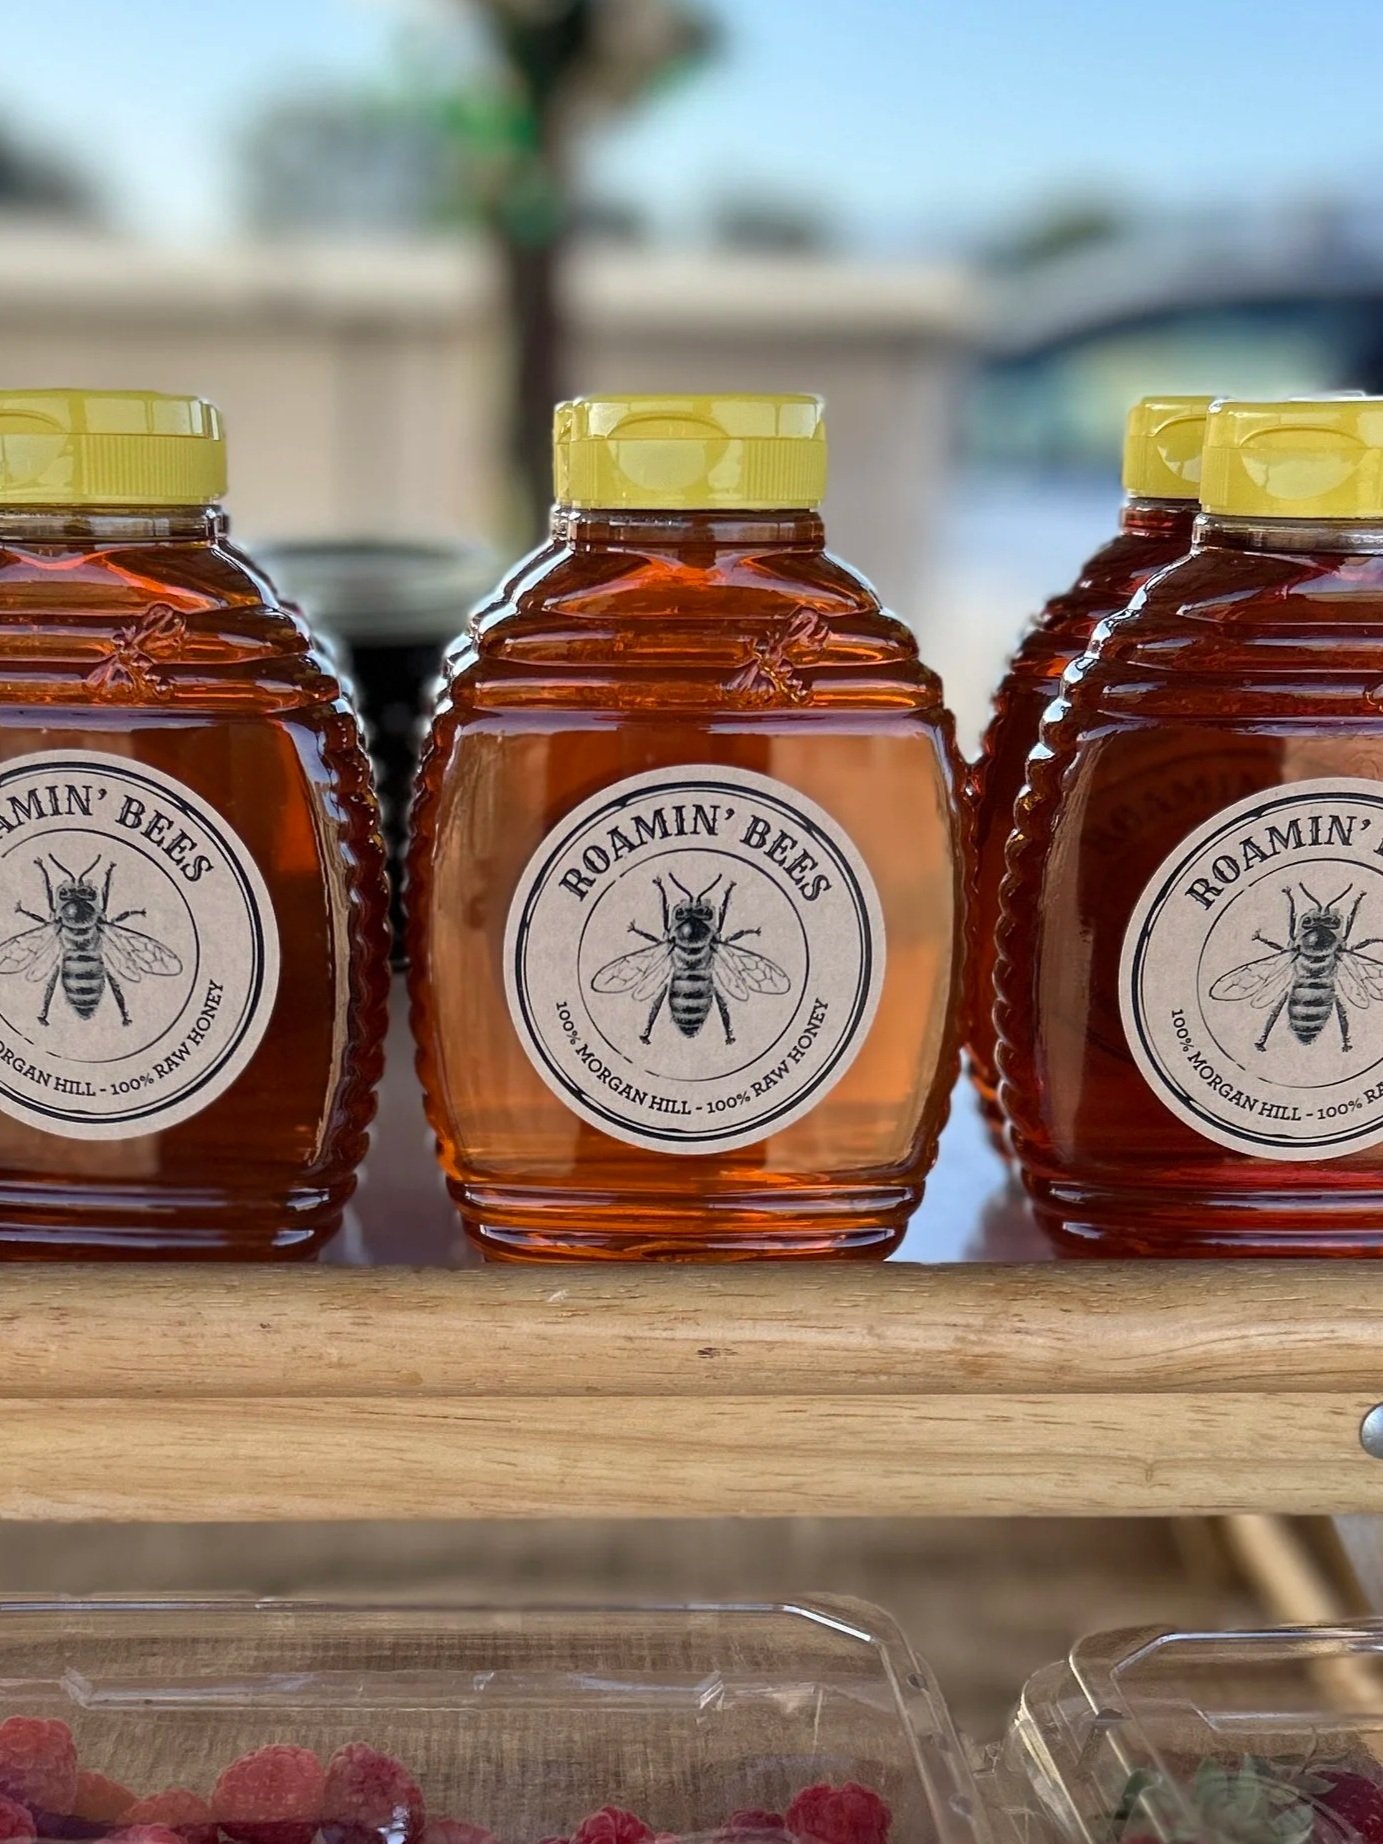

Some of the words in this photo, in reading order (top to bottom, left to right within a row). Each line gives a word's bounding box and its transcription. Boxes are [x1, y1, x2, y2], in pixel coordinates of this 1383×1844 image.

[0, 785, 107, 838] AMIN'
[115, 795, 214, 882] BEES
[559, 804, 735, 903] ROAMIN'
[740, 815, 832, 903] BEES
[1185, 815, 1371, 910] ROAMIN'
[54, 1078, 95, 1096] HILL
[111, 1073, 154, 1095] 100%
[153, 1042, 190, 1079] RAW
[186, 980, 223, 1044] HONEY
[556, 1001, 581, 1045] 100%
[576, 1043, 649, 1106] MORGAN
[648, 1096, 691, 1115] HILL
[707, 1093, 751, 1114] 100%
[750, 1061, 790, 1097] RAW
[788, 998, 829, 1064] HONEY
[1171, 1009, 1193, 1052] 100%
[1188, 1051, 1259, 1112] MORGAN
[1259, 1103, 1301, 1121] HILL
[1317, 1099, 1363, 1120] 100%
